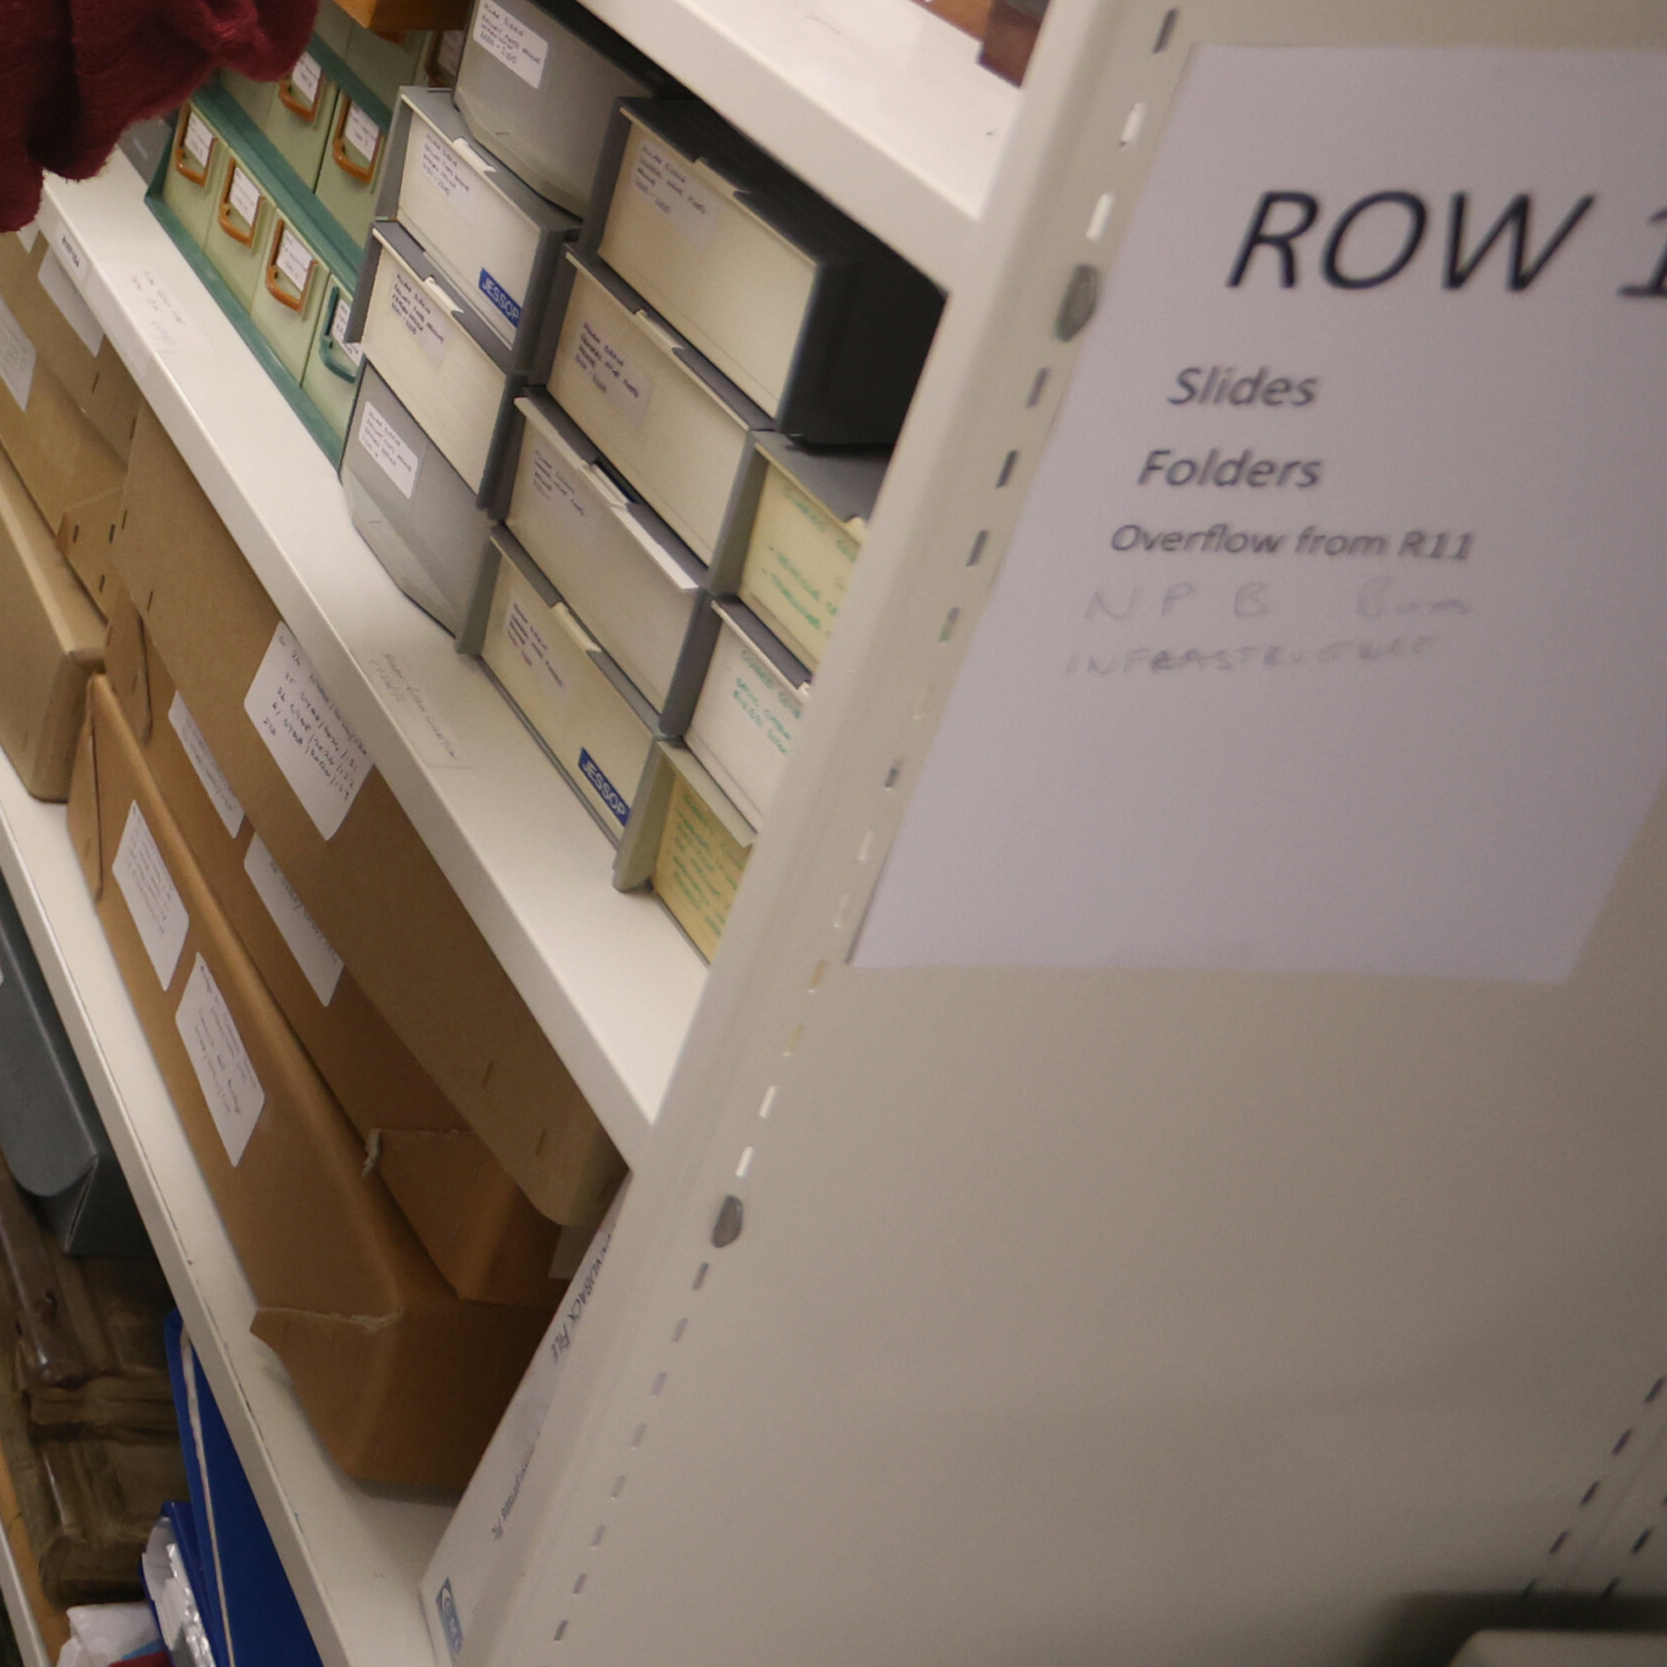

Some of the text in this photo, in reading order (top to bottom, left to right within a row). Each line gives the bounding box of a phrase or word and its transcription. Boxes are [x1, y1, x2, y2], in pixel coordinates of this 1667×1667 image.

[1227, 190, 1597, 293] ROW
[482, 278, 520, 320] JESSOP
[1168, 365, 1319, 408] Slides
[1136, 447, 1323, 490] Folders
[1110, 522, 1475, 563] Overflow from R11
[582, 760, 627, 815] JESSOP
